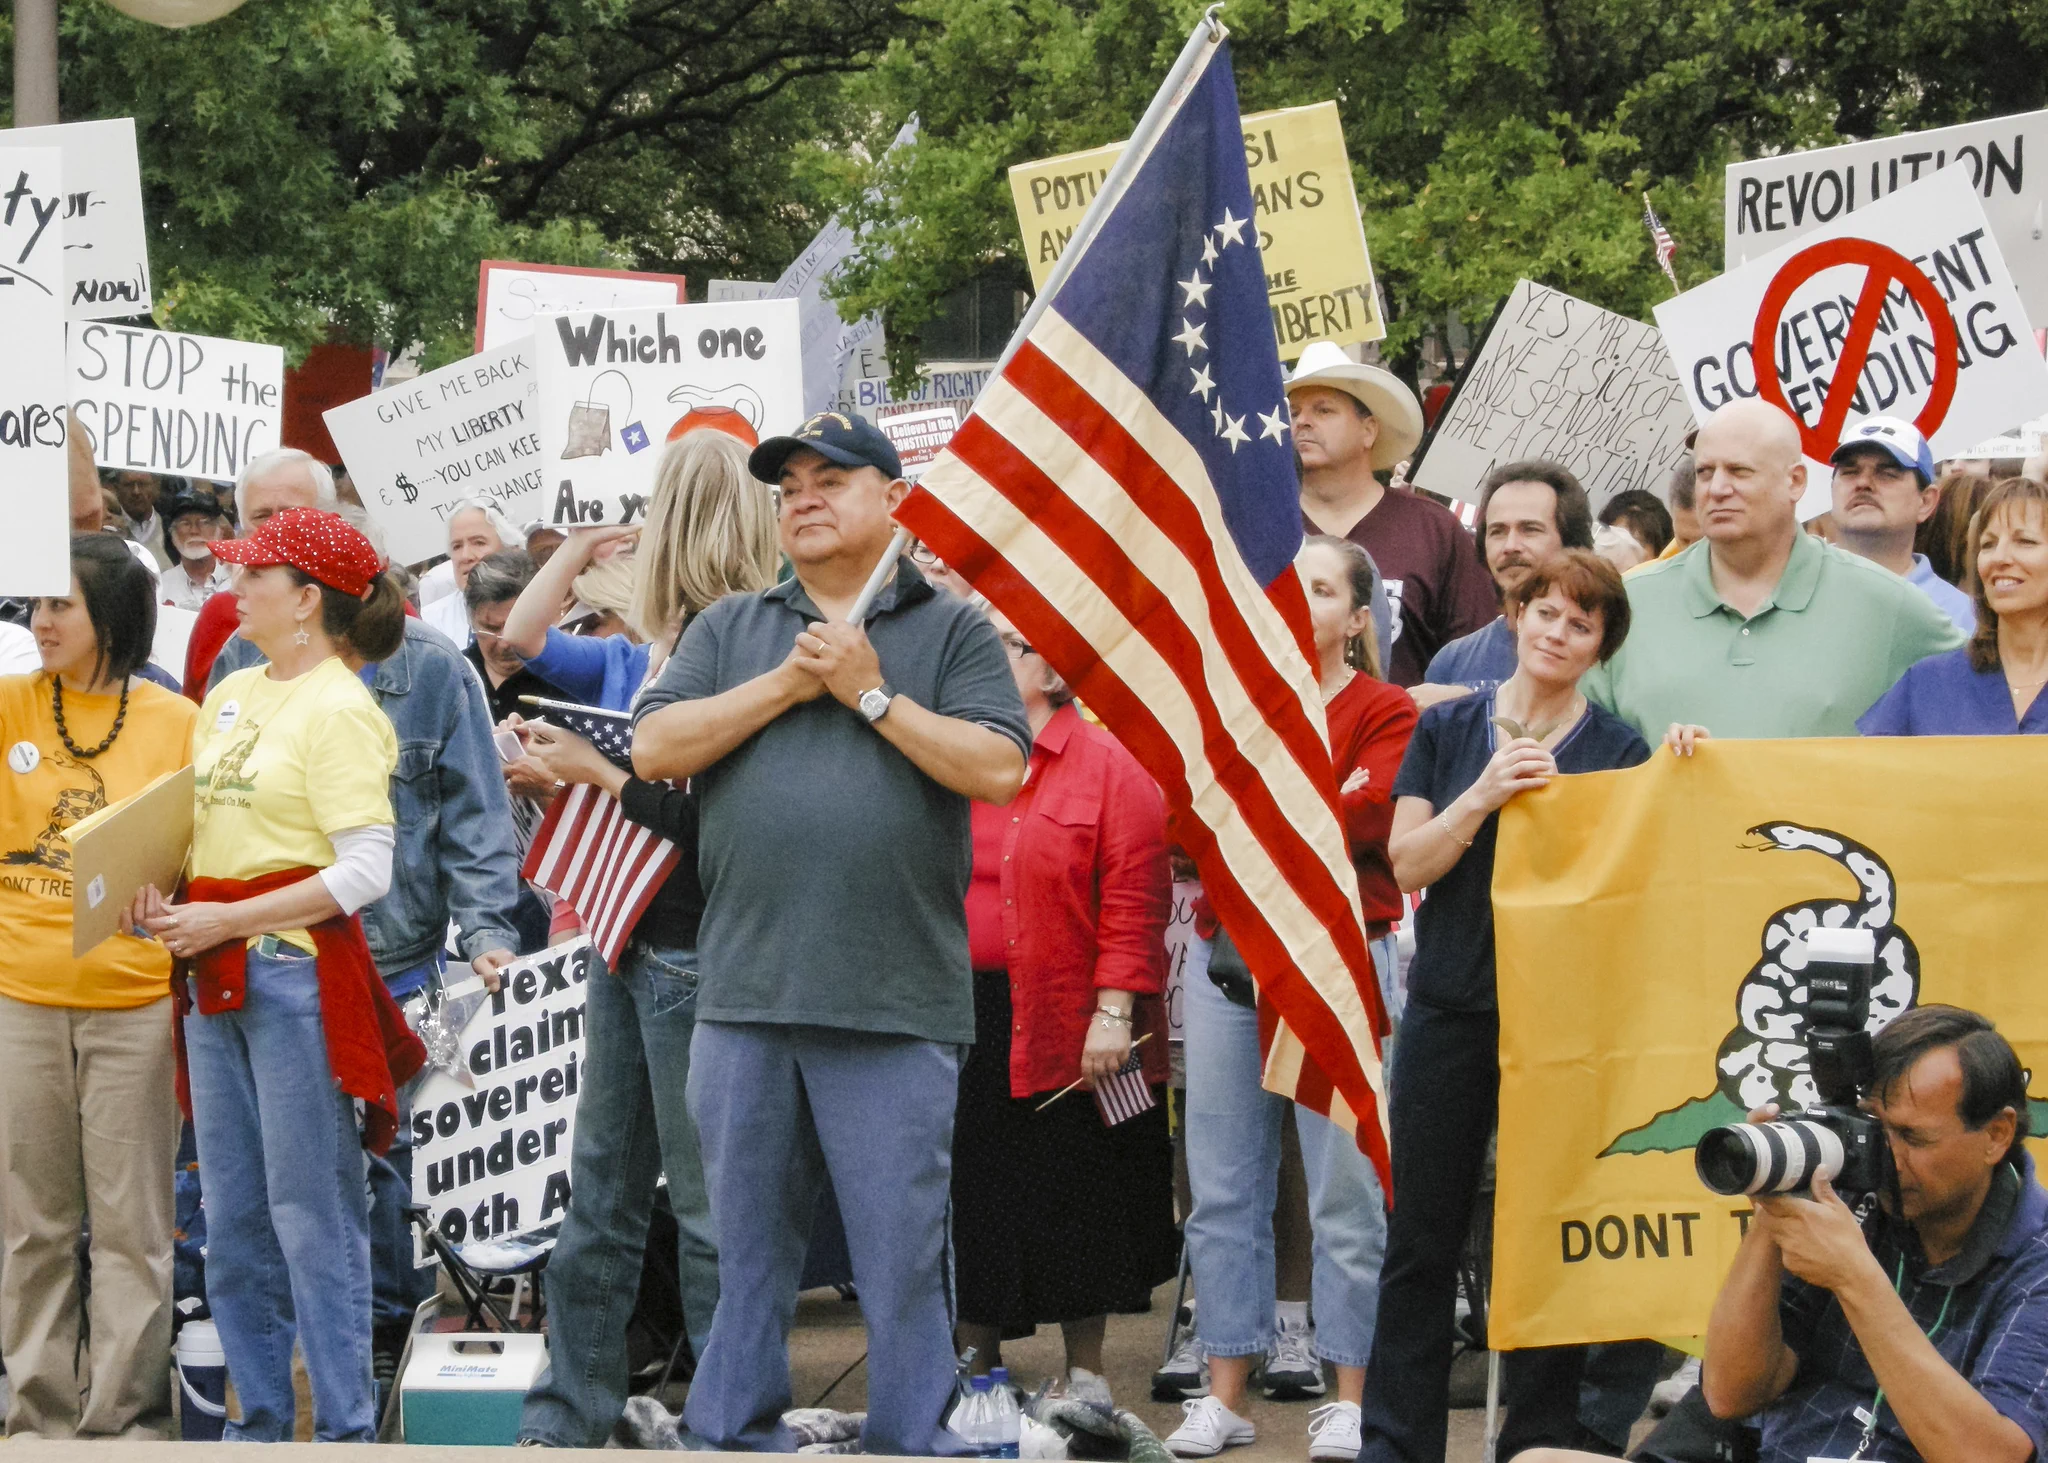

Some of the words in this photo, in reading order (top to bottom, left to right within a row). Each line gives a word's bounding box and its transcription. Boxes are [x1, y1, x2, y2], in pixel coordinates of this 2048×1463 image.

[1738, 134, 2023, 235] REVOLUTION
[1516, 282, 1575, 339] YES
[77, 324, 204, 395] STOP
[221, 362, 277, 408] the
[555, 312, 681, 367] Which
[697, 326, 766, 361] one
[1493, 328, 1553, 373] WE
[1549, 348, 1581, 388] R
[377, 390, 431, 424] GIVE
[439, 374, 472, 401] ME
[474, 354, 530, 388] BACK
[859, 381, 894, 407] BIL
[1461, 359, 1518, 407] AND
[73, 398, 268, 476] SPENDING
[416, 431, 444, 458] MY
[451, 400, 526, 447] LIBERTY
[892, 421, 927, 439] Believe
[927, 420, 938, 432] in
[938, 417, 954, 431] the
[1442, 397, 1507, 451] ARE
[475, 446, 507, 471] CAN
[509, 433, 541, 460] KEE
[479, 469, 543, 501] HANG
[552, 479, 604, 524] Are
[412, 1050, 586, 1148] soverei
[426, 1117, 568, 1197] under
[1561, 1211, 1701, 1264] DONT
[439, 1364, 499, 1373] MiniMate
